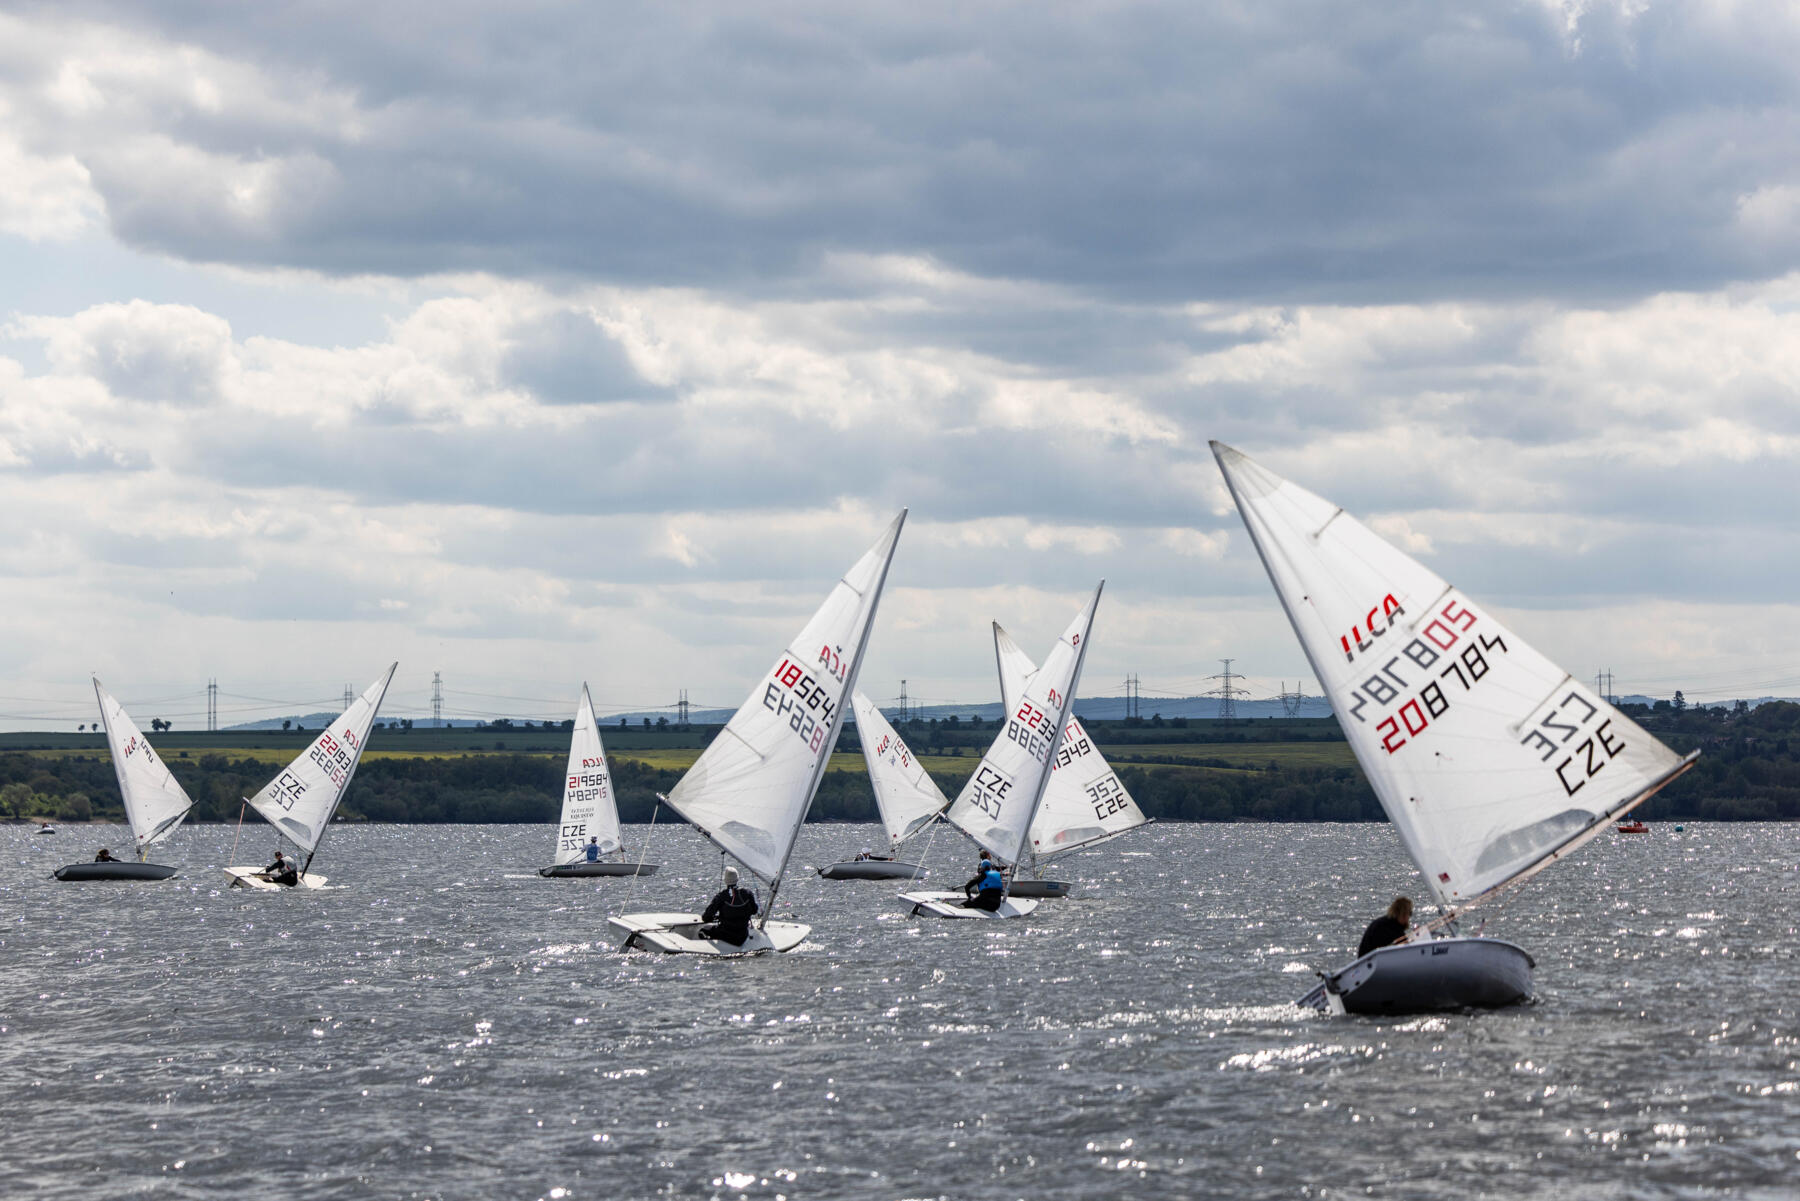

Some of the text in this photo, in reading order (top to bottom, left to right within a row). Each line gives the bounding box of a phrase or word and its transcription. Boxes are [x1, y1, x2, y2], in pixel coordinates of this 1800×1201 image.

[1340, 593, 1405, 663] ILCA
[1376, 633, 1508, 754] 208784
[319, 734, 352, 774] 22193
[1555, 718, 1626, 797] CZE
[279, 772, 306, 800] CZE
[569, 773, 607, 788] 219584
[976, 766, 1013, 800] CZE
[1095, 792, 1128, 821] CZE
[562, 824, 586, 837] CZE
